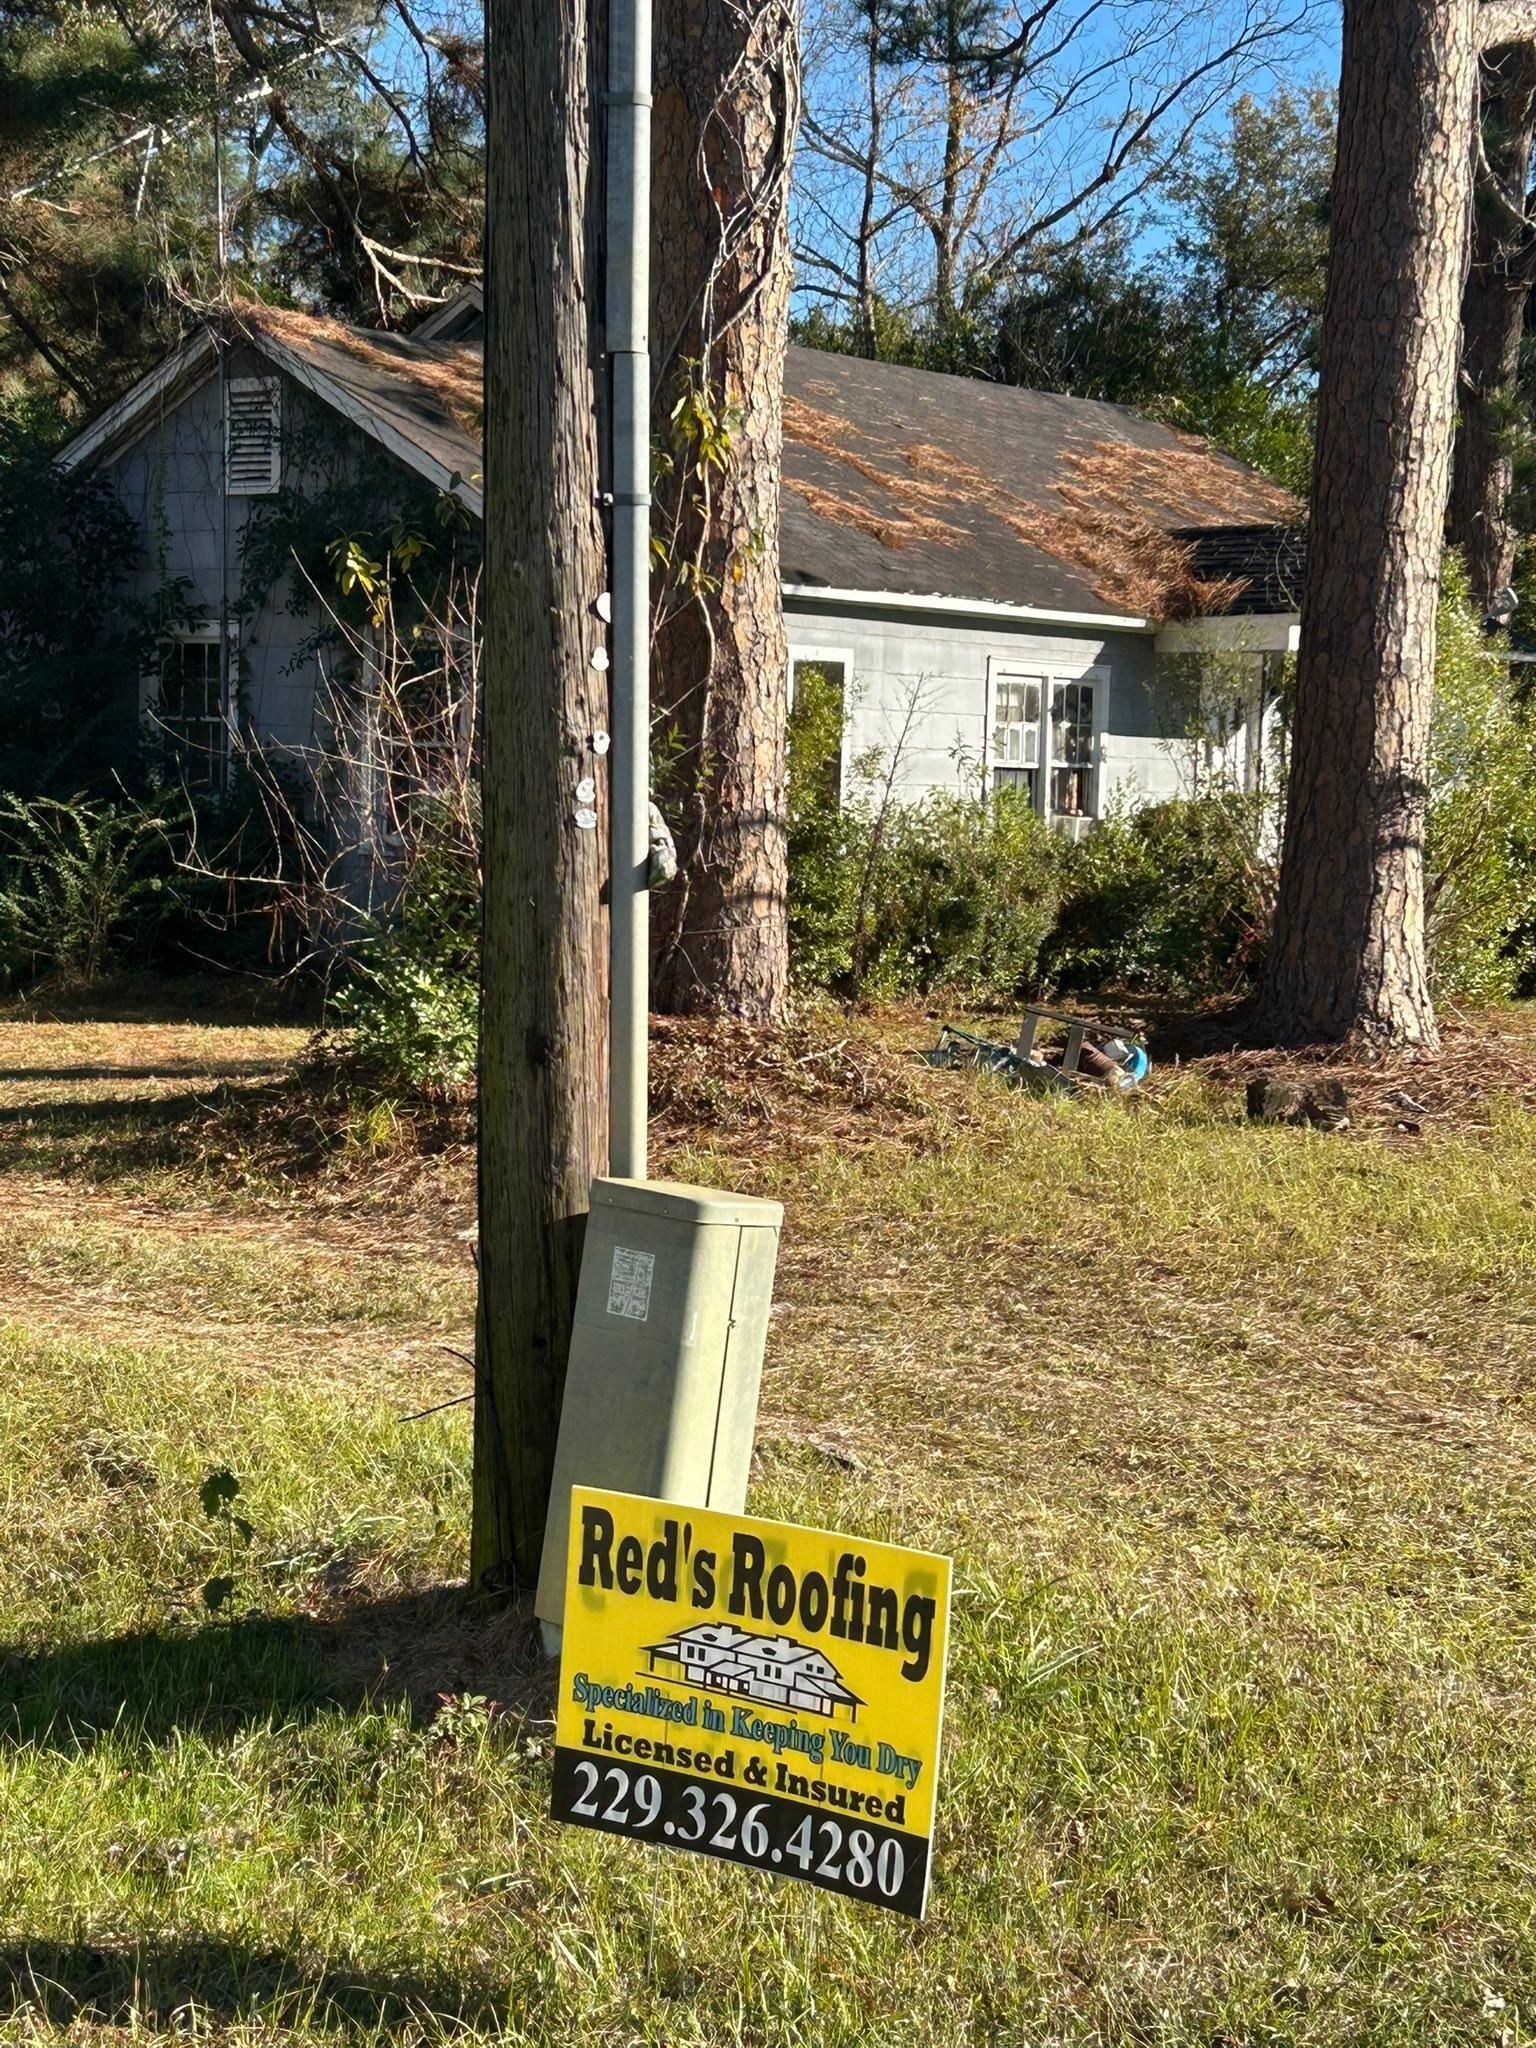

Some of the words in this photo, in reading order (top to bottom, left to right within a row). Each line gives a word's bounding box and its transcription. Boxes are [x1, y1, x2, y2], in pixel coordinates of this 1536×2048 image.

[578, 1505, 716, 1609] Red's
[728, 1532, 936, 1682] Roofing
[573, 1672, 697, 1725] Specialized
[702, 1700, 725, 1732] in
[731, 1705, 825, 1764] Keeping
[829, 1728, 872, 1769] You
[876, 1742, 922, 1789] Dry
[582, 1719, 736, 1778] Licensed
[744, 1756, 769, 1784] &
[775, 1762, 905, 1825] Insured
[570, 1761, 904, 1897] 229.326.4280
